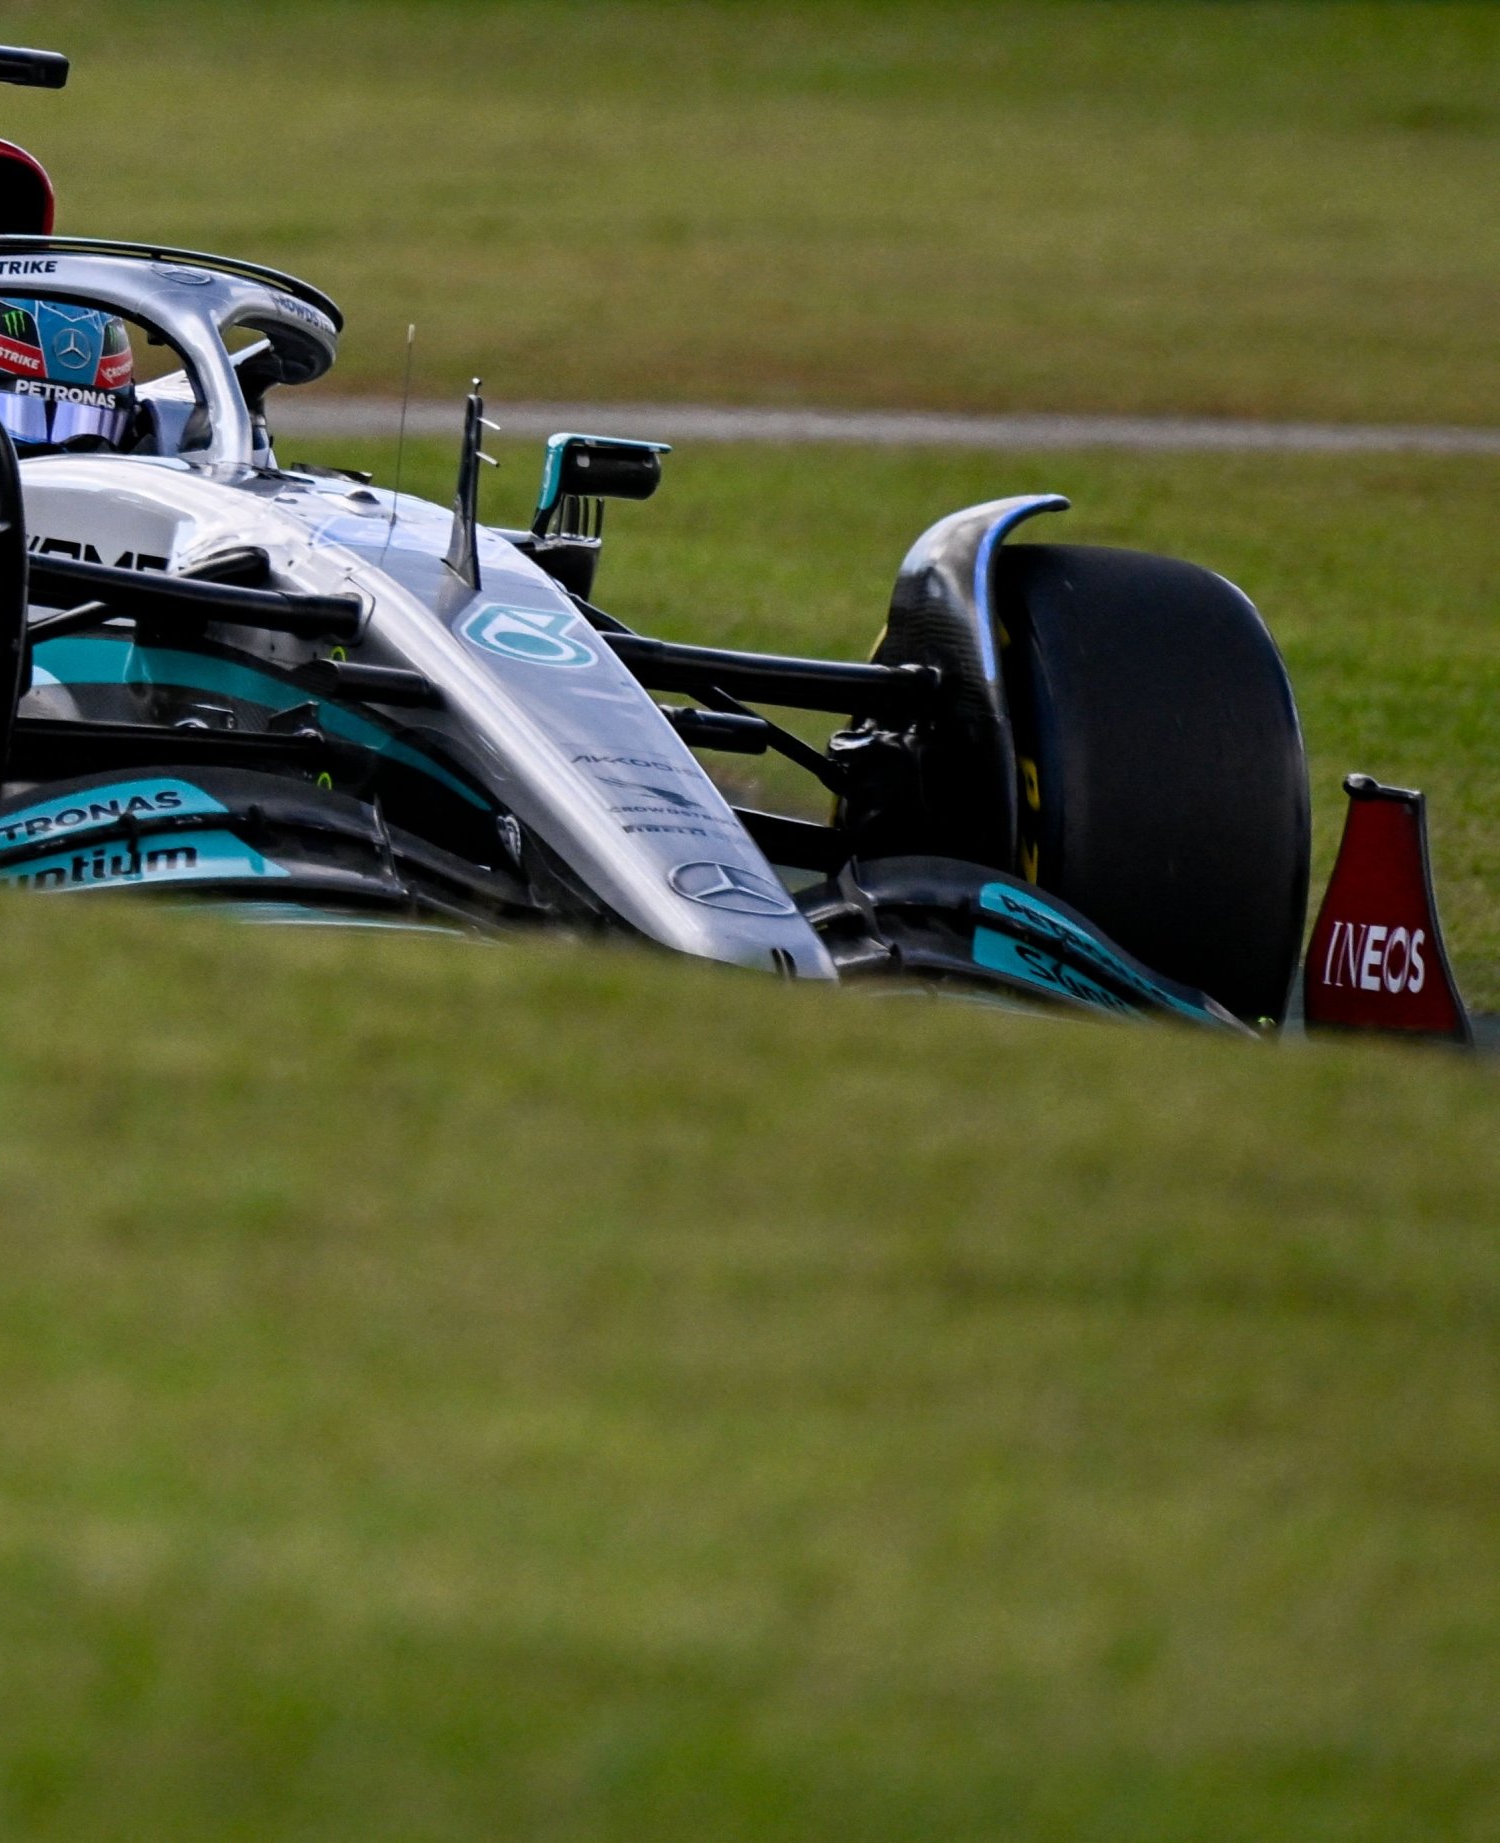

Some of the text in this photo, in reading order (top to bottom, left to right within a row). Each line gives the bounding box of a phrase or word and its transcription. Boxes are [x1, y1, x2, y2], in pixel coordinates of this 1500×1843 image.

[15, 379, 116, 409] PETRONAS
[572, 755, 703, 781] AKKOD
[611, 805, 740, 829] CROWDSTR
[1322, 921, 1426, 994] INEOS
